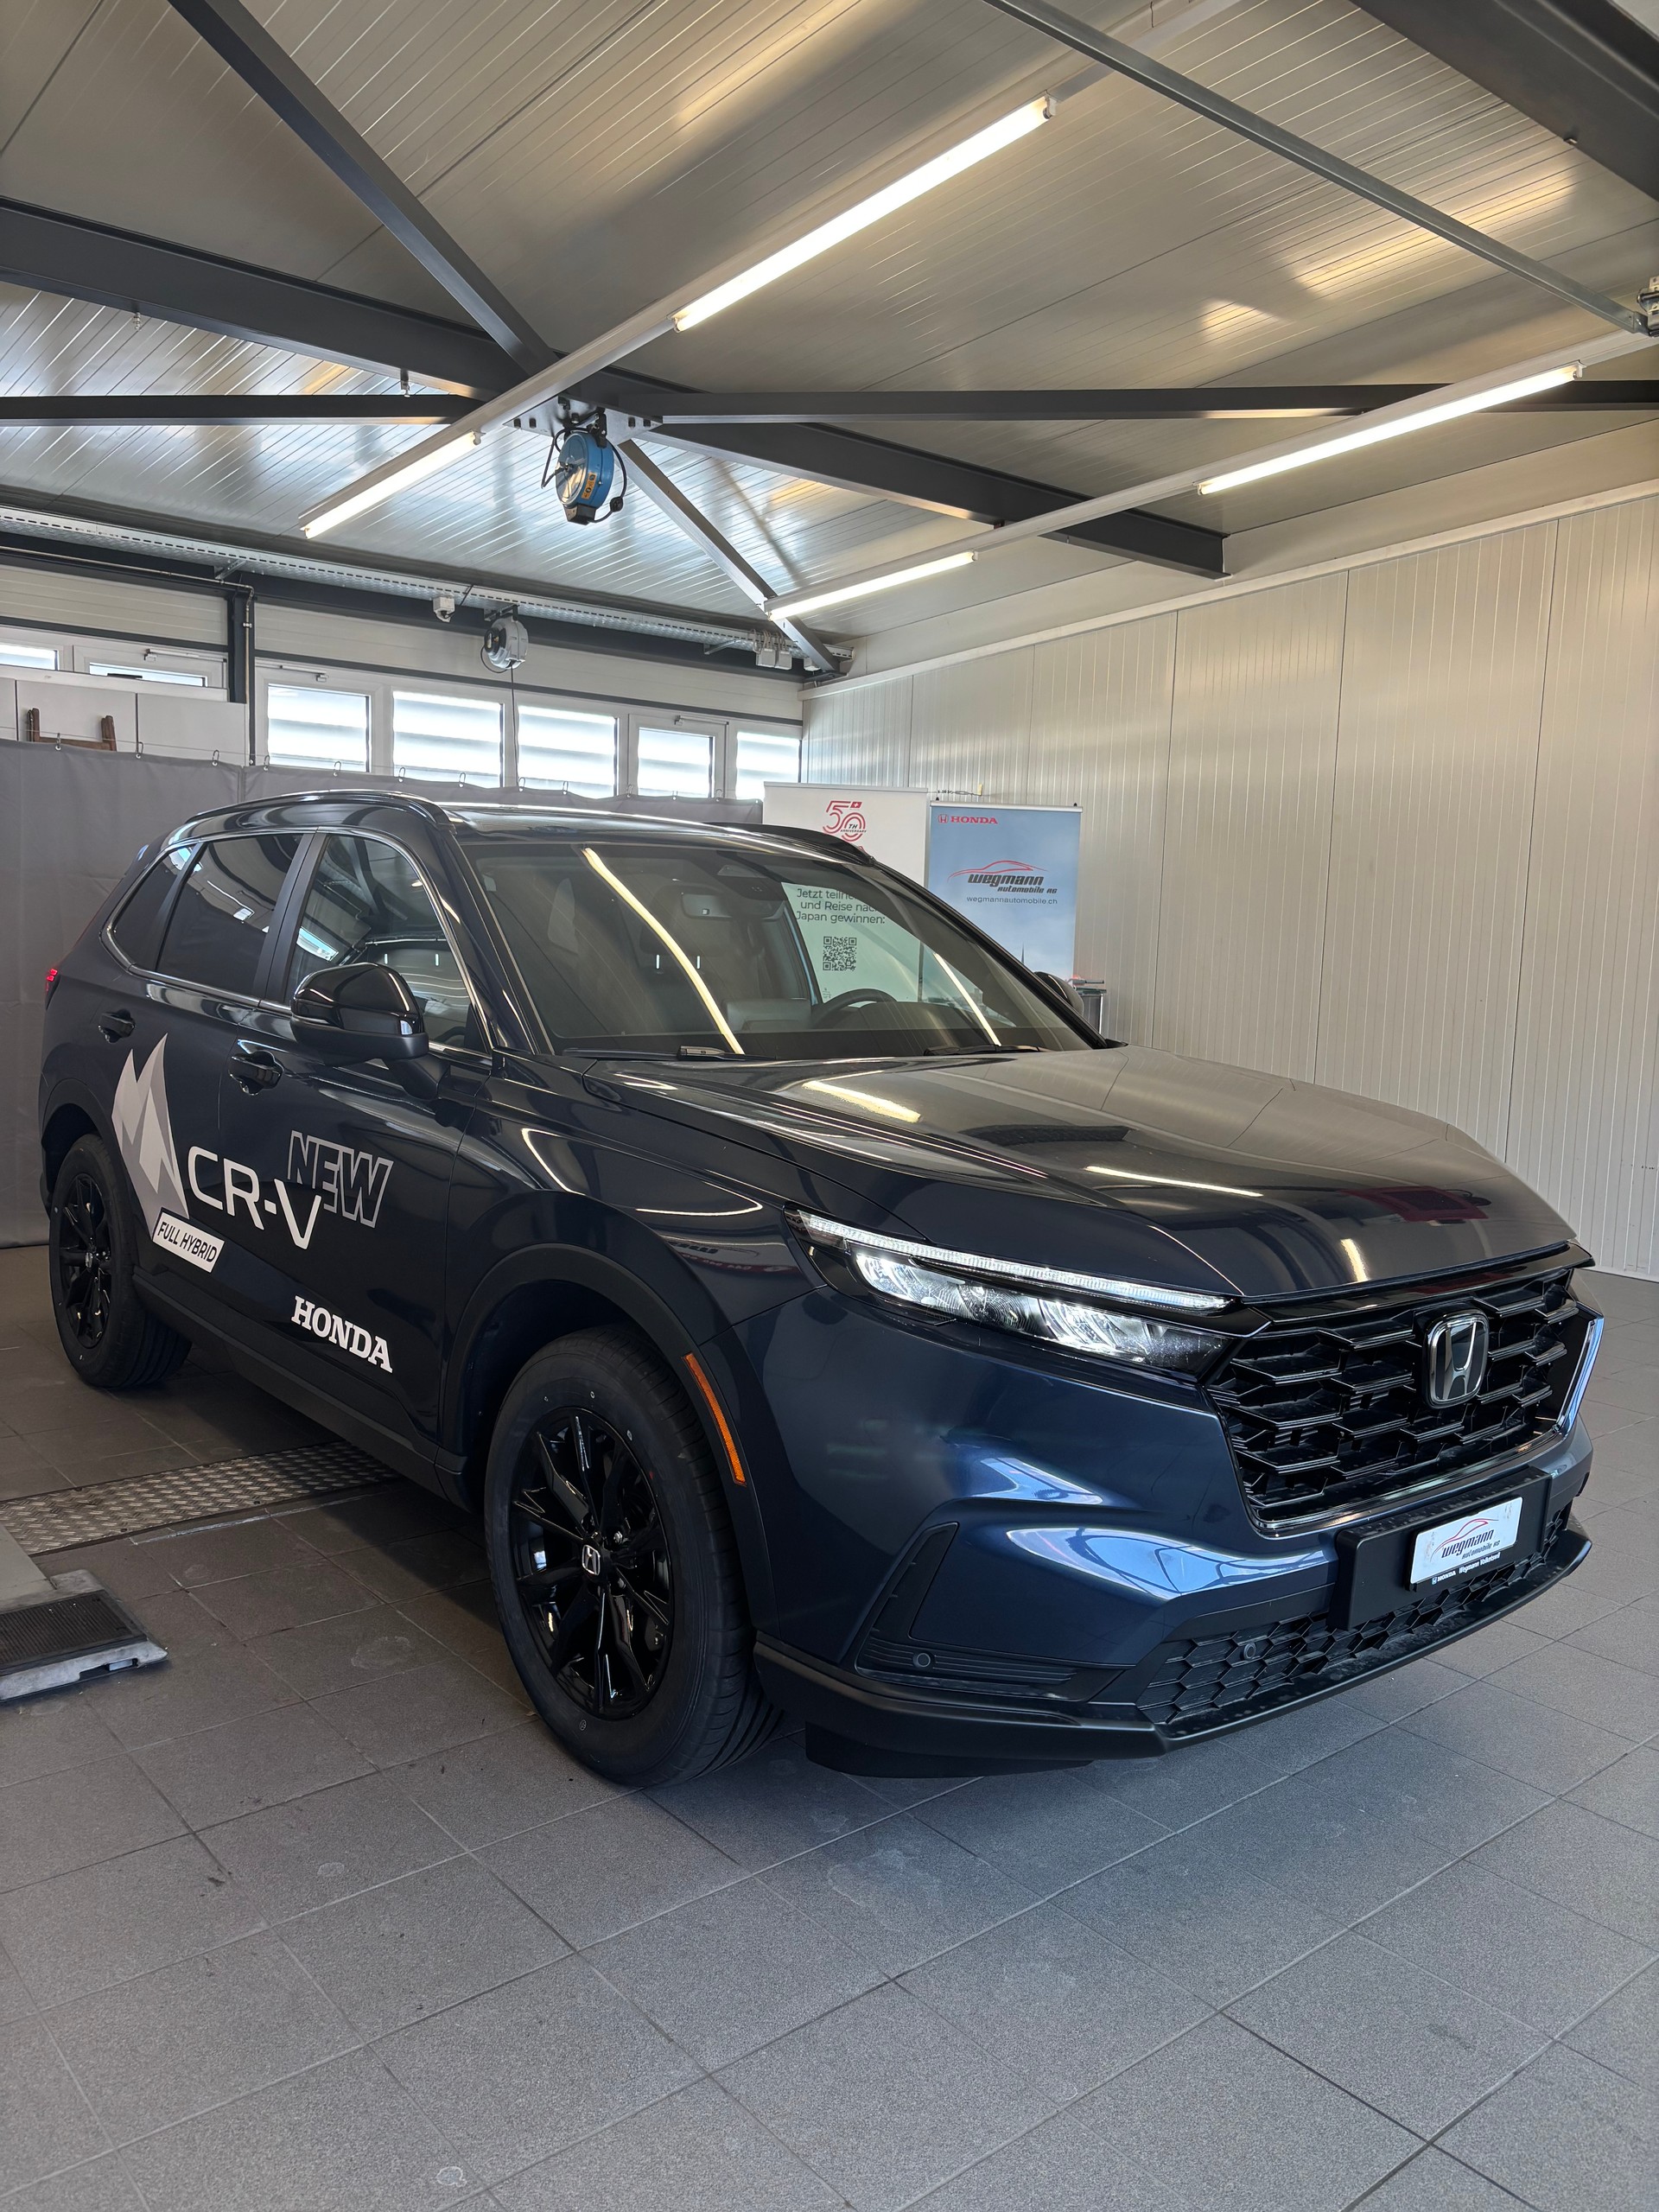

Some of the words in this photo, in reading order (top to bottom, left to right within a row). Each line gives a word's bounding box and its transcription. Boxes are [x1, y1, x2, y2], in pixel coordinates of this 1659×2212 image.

[823, 800, 866, 842] 50
[950, 816, 998, 824] HONDA
[967, 874, 1044, 887] wegmann
[797, 888, 823, 899] Jetzt
[997, 885, 1045, 893] automobile
[800, 901, 821, 910] und
[824, 901, 853, 911] Reise
[855, 903, 877, 912] nac
[966, 896, 1058, 905] wegmannautomobile.ch
[797, 911, 827, 922] Japan
[830, 912, 886, 925] gewinnen:
[287, 1130, 394, 1229] NEW
[188, 1146, 322, 1250] CR-V
[157, 1221, 181, 1246] FULL
[179, 1232, 218, 1263] HYBRID
[291, 1295, 393, 1374] HONDA
[1441, 1529, 1495, 1558] wegmann
